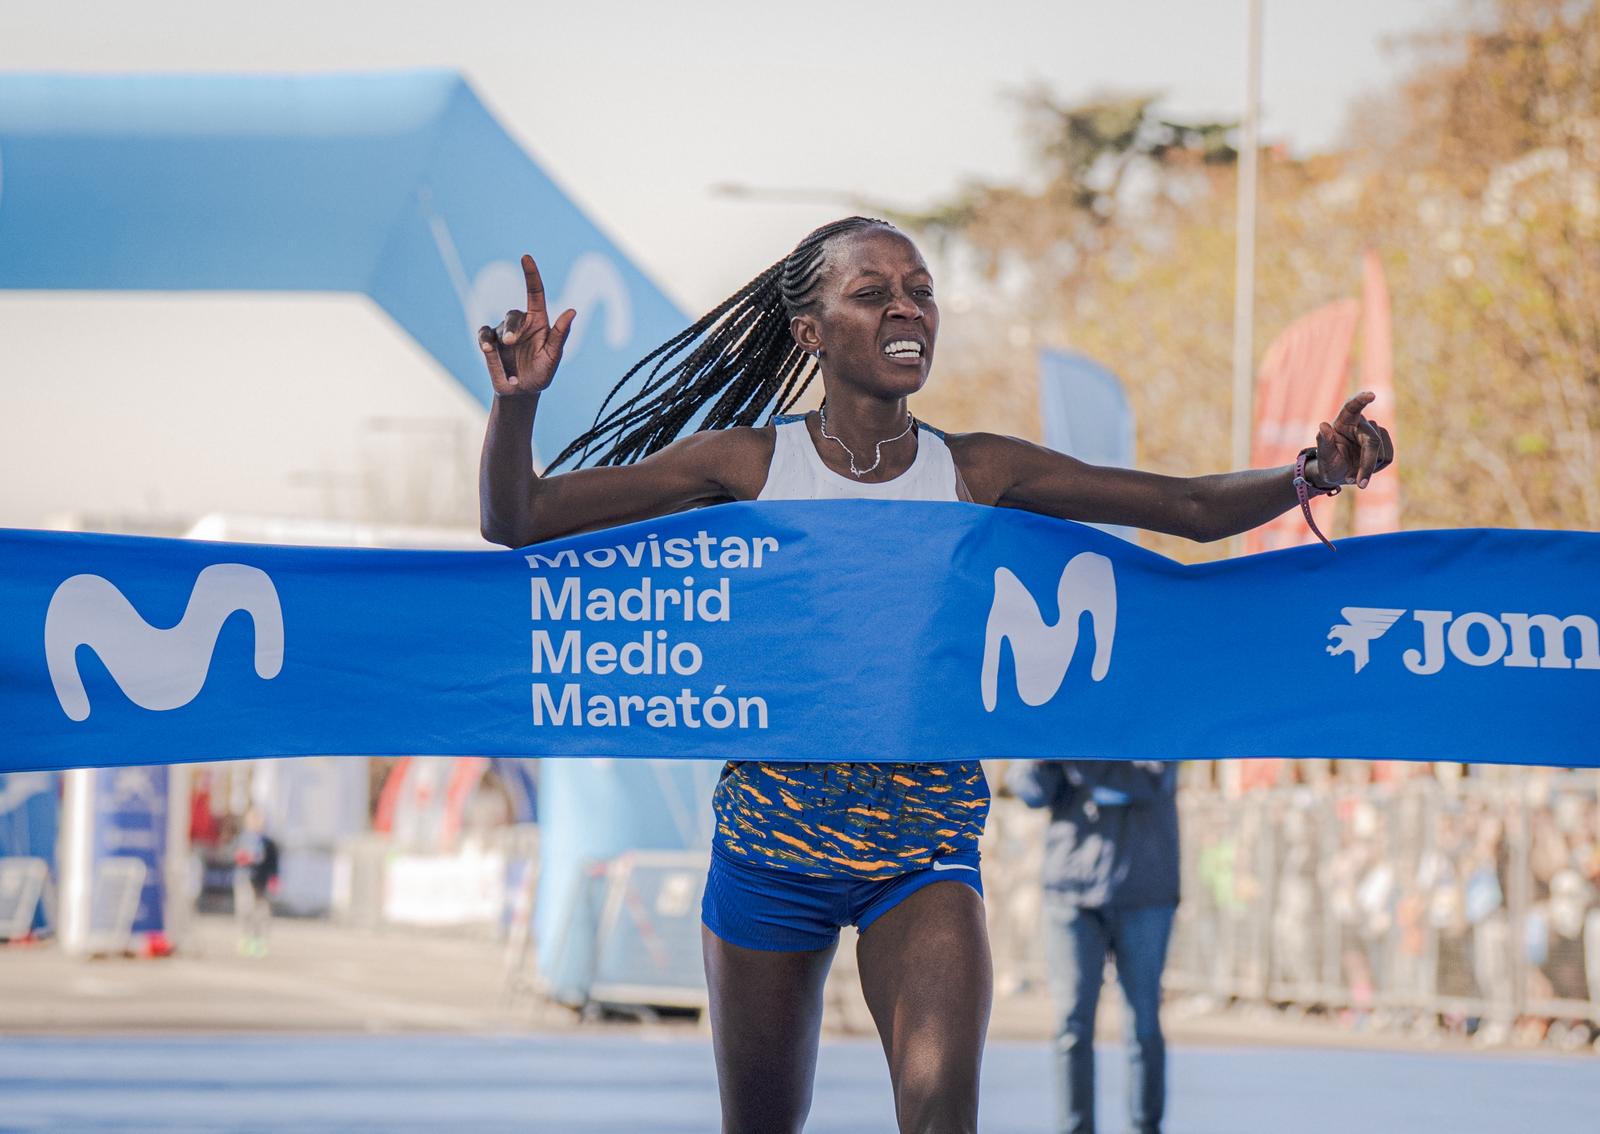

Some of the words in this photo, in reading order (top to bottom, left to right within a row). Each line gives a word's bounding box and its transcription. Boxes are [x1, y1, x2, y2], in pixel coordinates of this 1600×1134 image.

[524, 530, 779, 569] Movistar
[530, 576, 730, 622] Madrid
[531, 629, 703, 676] Medio
[531, 682, 768, 729] Maratón
